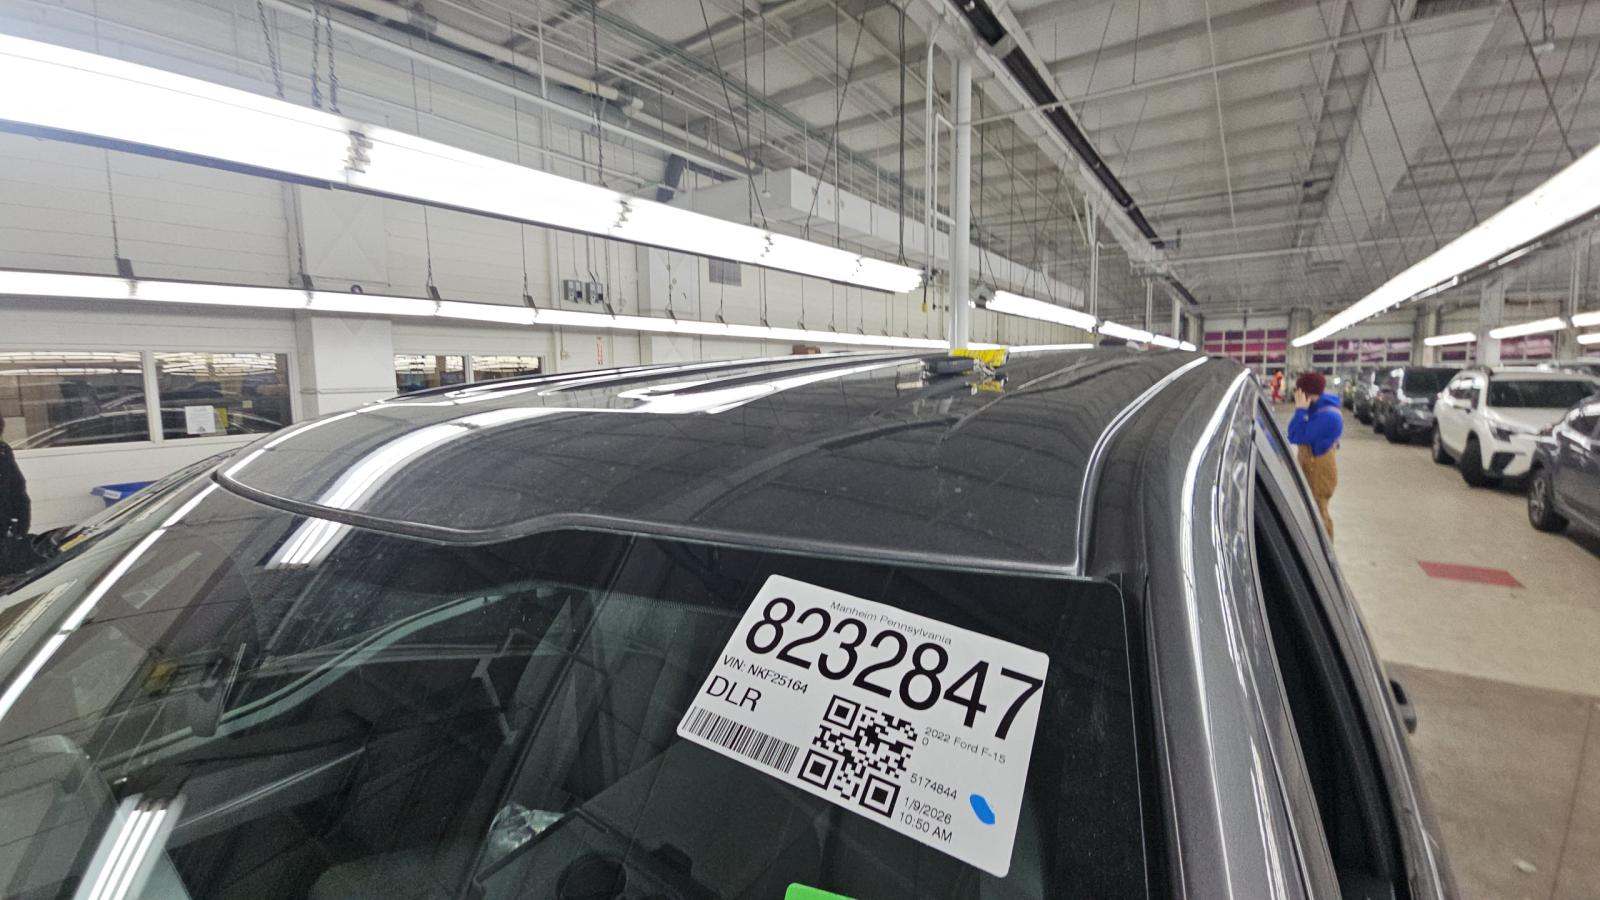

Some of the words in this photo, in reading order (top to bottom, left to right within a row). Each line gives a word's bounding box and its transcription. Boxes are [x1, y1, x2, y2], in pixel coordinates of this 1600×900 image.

[830, 601, 877, 622] Manheim
[879, 615, 952, 646] Pennsylvania
[723, 654, 747, 671] VIN:
[749, 664, 808, 694] NKF25164
[746, 597, 1044, 740] 8232847
[706, 675, 762, 712] DLR
[924, 726, 951, 744] 2022
[953, 736, 979, 754] Ford
[981, 747, 1006, 765] F-15
[910, 773, 958, 800] 5174844
[900, 811, 930, 833] 10:50
[932, 826, 953, 844] AM
[904, 796, 952, 825] 1/9/2026
